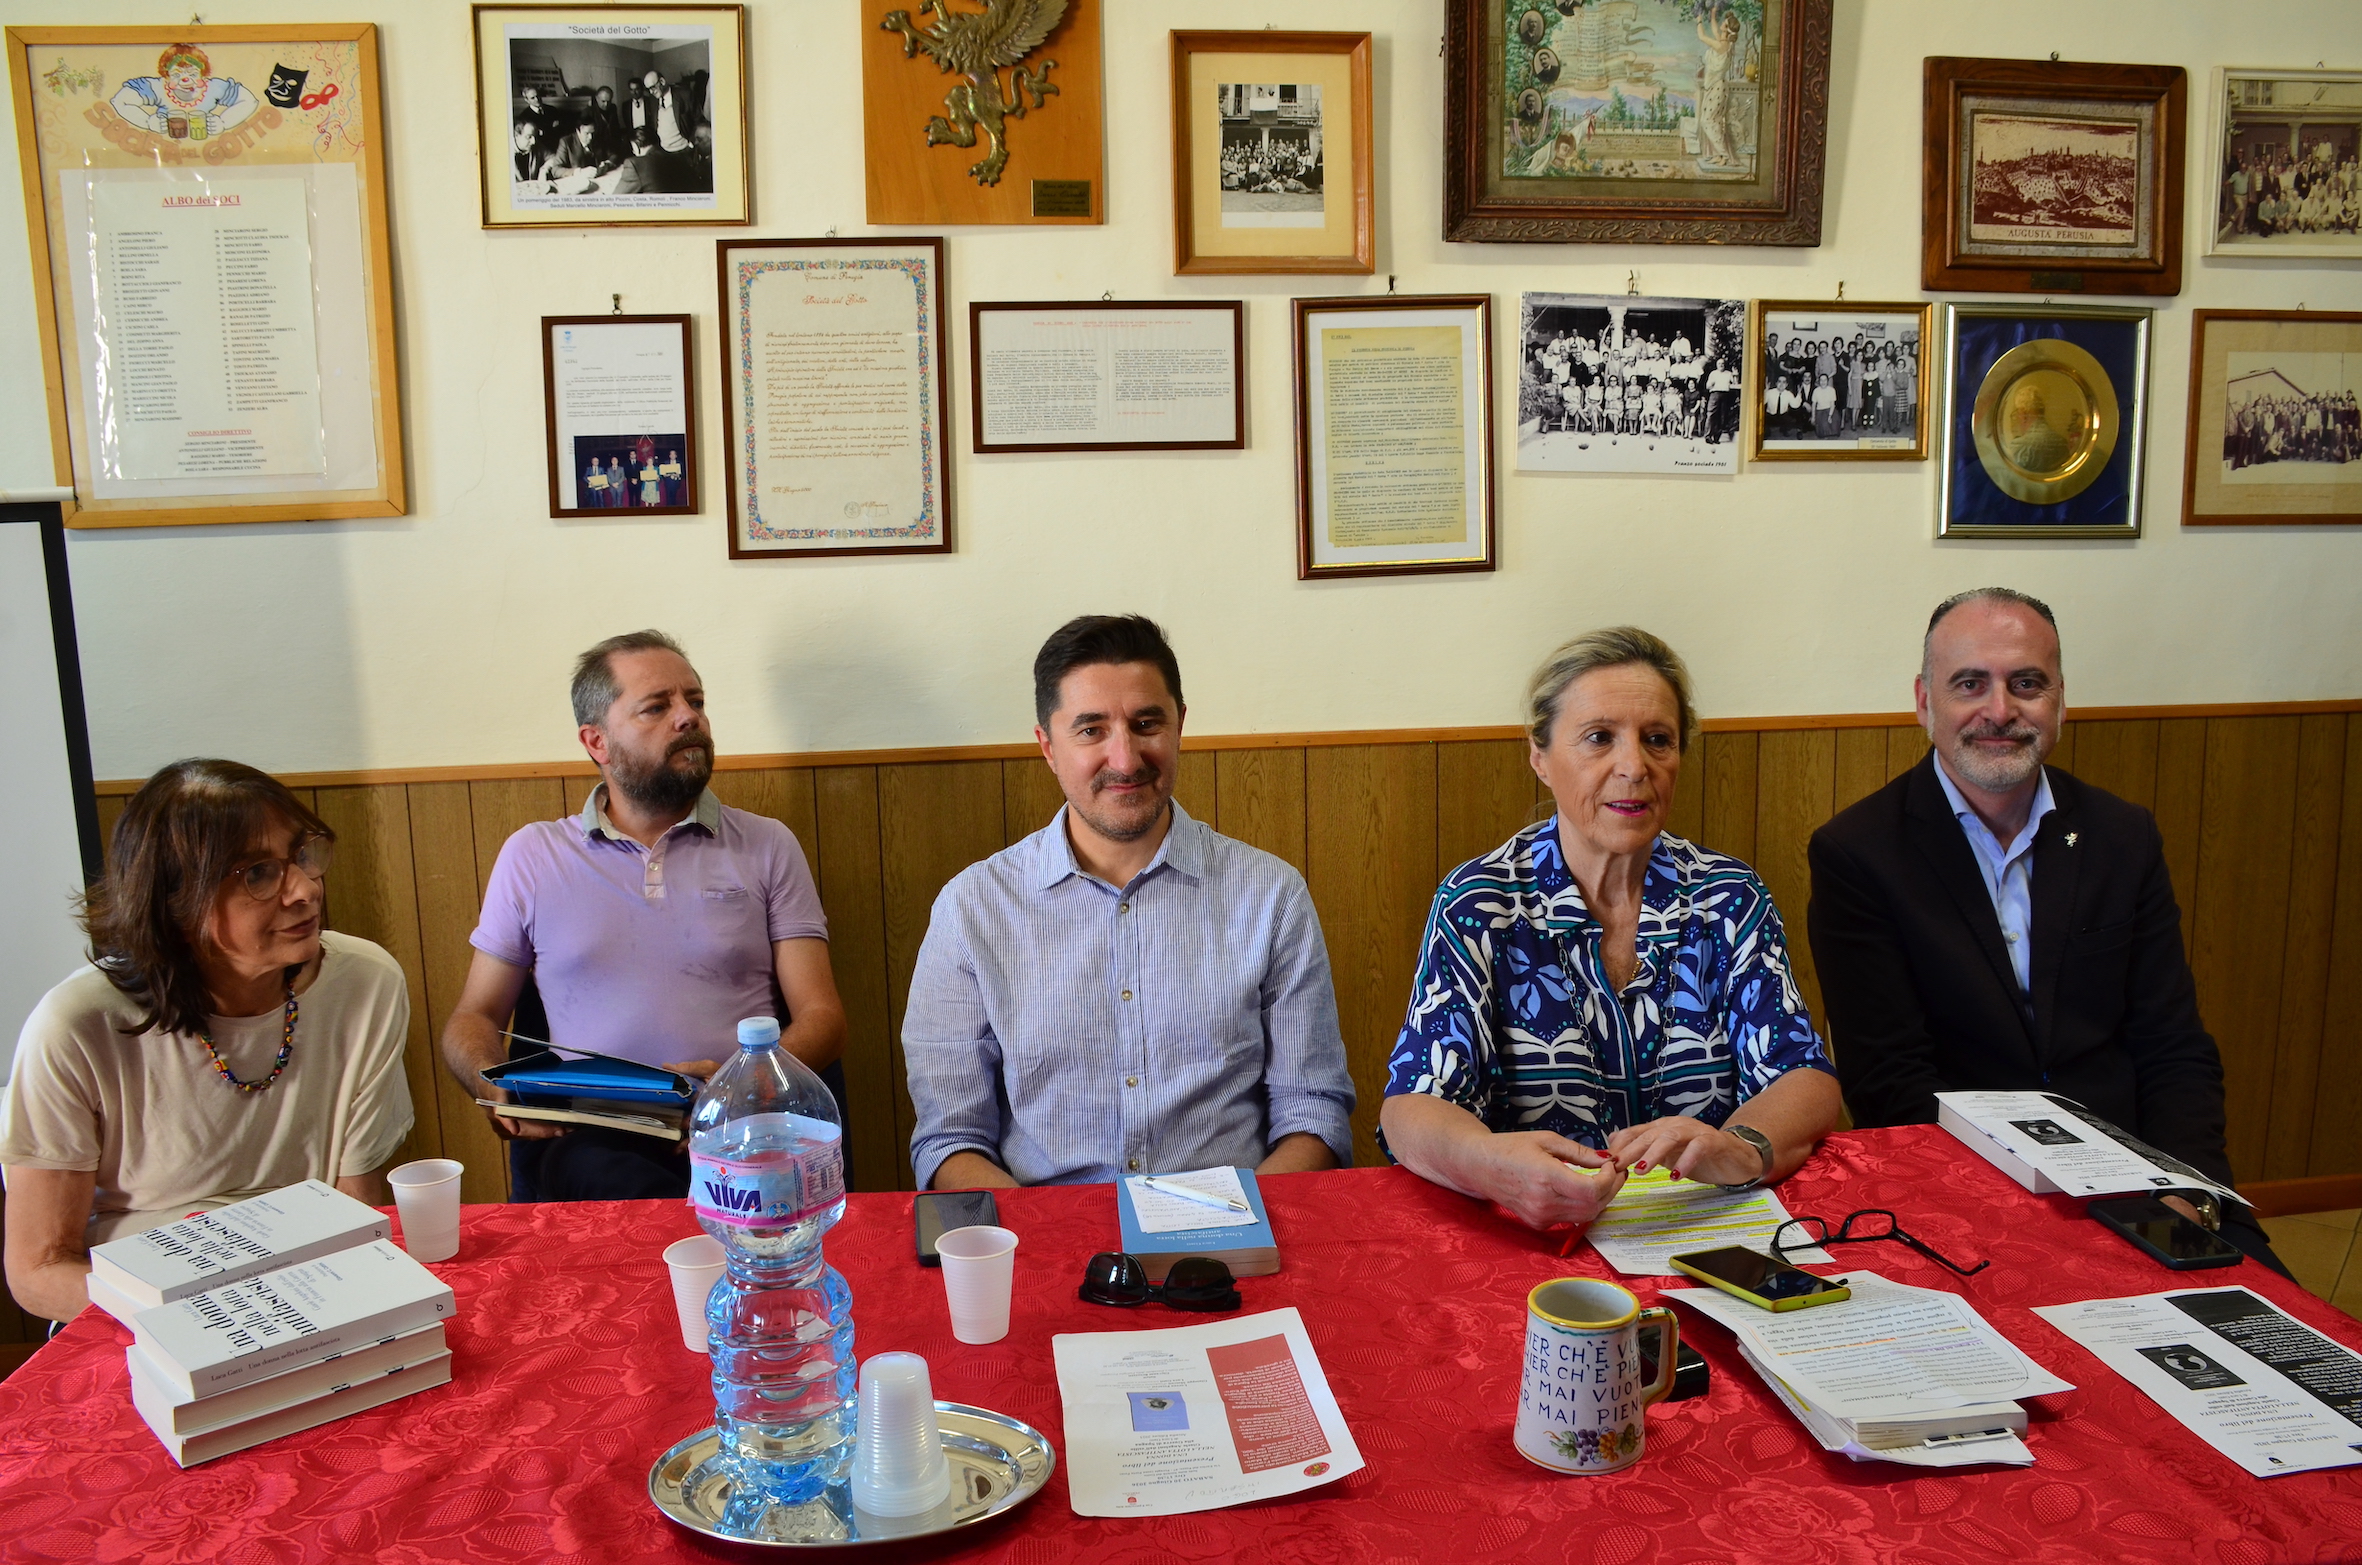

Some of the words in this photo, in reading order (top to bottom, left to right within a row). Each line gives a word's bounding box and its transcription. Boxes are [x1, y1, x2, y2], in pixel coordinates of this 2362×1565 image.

[608, 26, 620, 34] del
[181, 147, 200, 159] DEL
[203, 106, 283, 165] GOTTO
[162, 197, 193, 206] ALBO
[196, 196, 210, 205] dei
[212, 195, 240, 205] SOCI
[2008, 229, 2051, 238] AUGUSTA
[2057, 231, 2094, 239] PERUSIA
[832, 296, 844, 304] del
[704, 1181, 762, 1212] VIVA
[717, 1208, 746, 1218] NATURALE
[138, 1229, 193, 1257] donna
[171, 1224, 204, 1244] lotta
[187, 1214, 276, 1260] antifascista
[199, 1240, 238, 1261] nella
[187, 1255, 226, 1279] Una
[186, 1293, 235, 1329] donna
[220, 1289, 253, 1314] lotta
[240, 1277, 321, 1338] antifascista
[243, 1311, 281, 1338] nella
[226, 1329, 263, 1359] Una
[211, 1373, 226, 1381] Luca
[228, 1368, 243, 1376] Gatti
[248, 1362, 260, 1370] Una
[262, 1356, 279, 1365] donna
[310, 1337, 340, 1350] antifascista
[1540, 1380, 1575, 1401] MAI
[1593, 1374, 1639, 1403] VUOT
[1539, 1402, 1575, 1425] MAI
[1597, 1396, 1642, 1425] PIEN
[2200, 1407, 2250, 1416] ANTIFASCISTA
[2256, 1413, 2314, 1423] Presentazione
[1158, 1457, 1214, 1465] Presentazione
